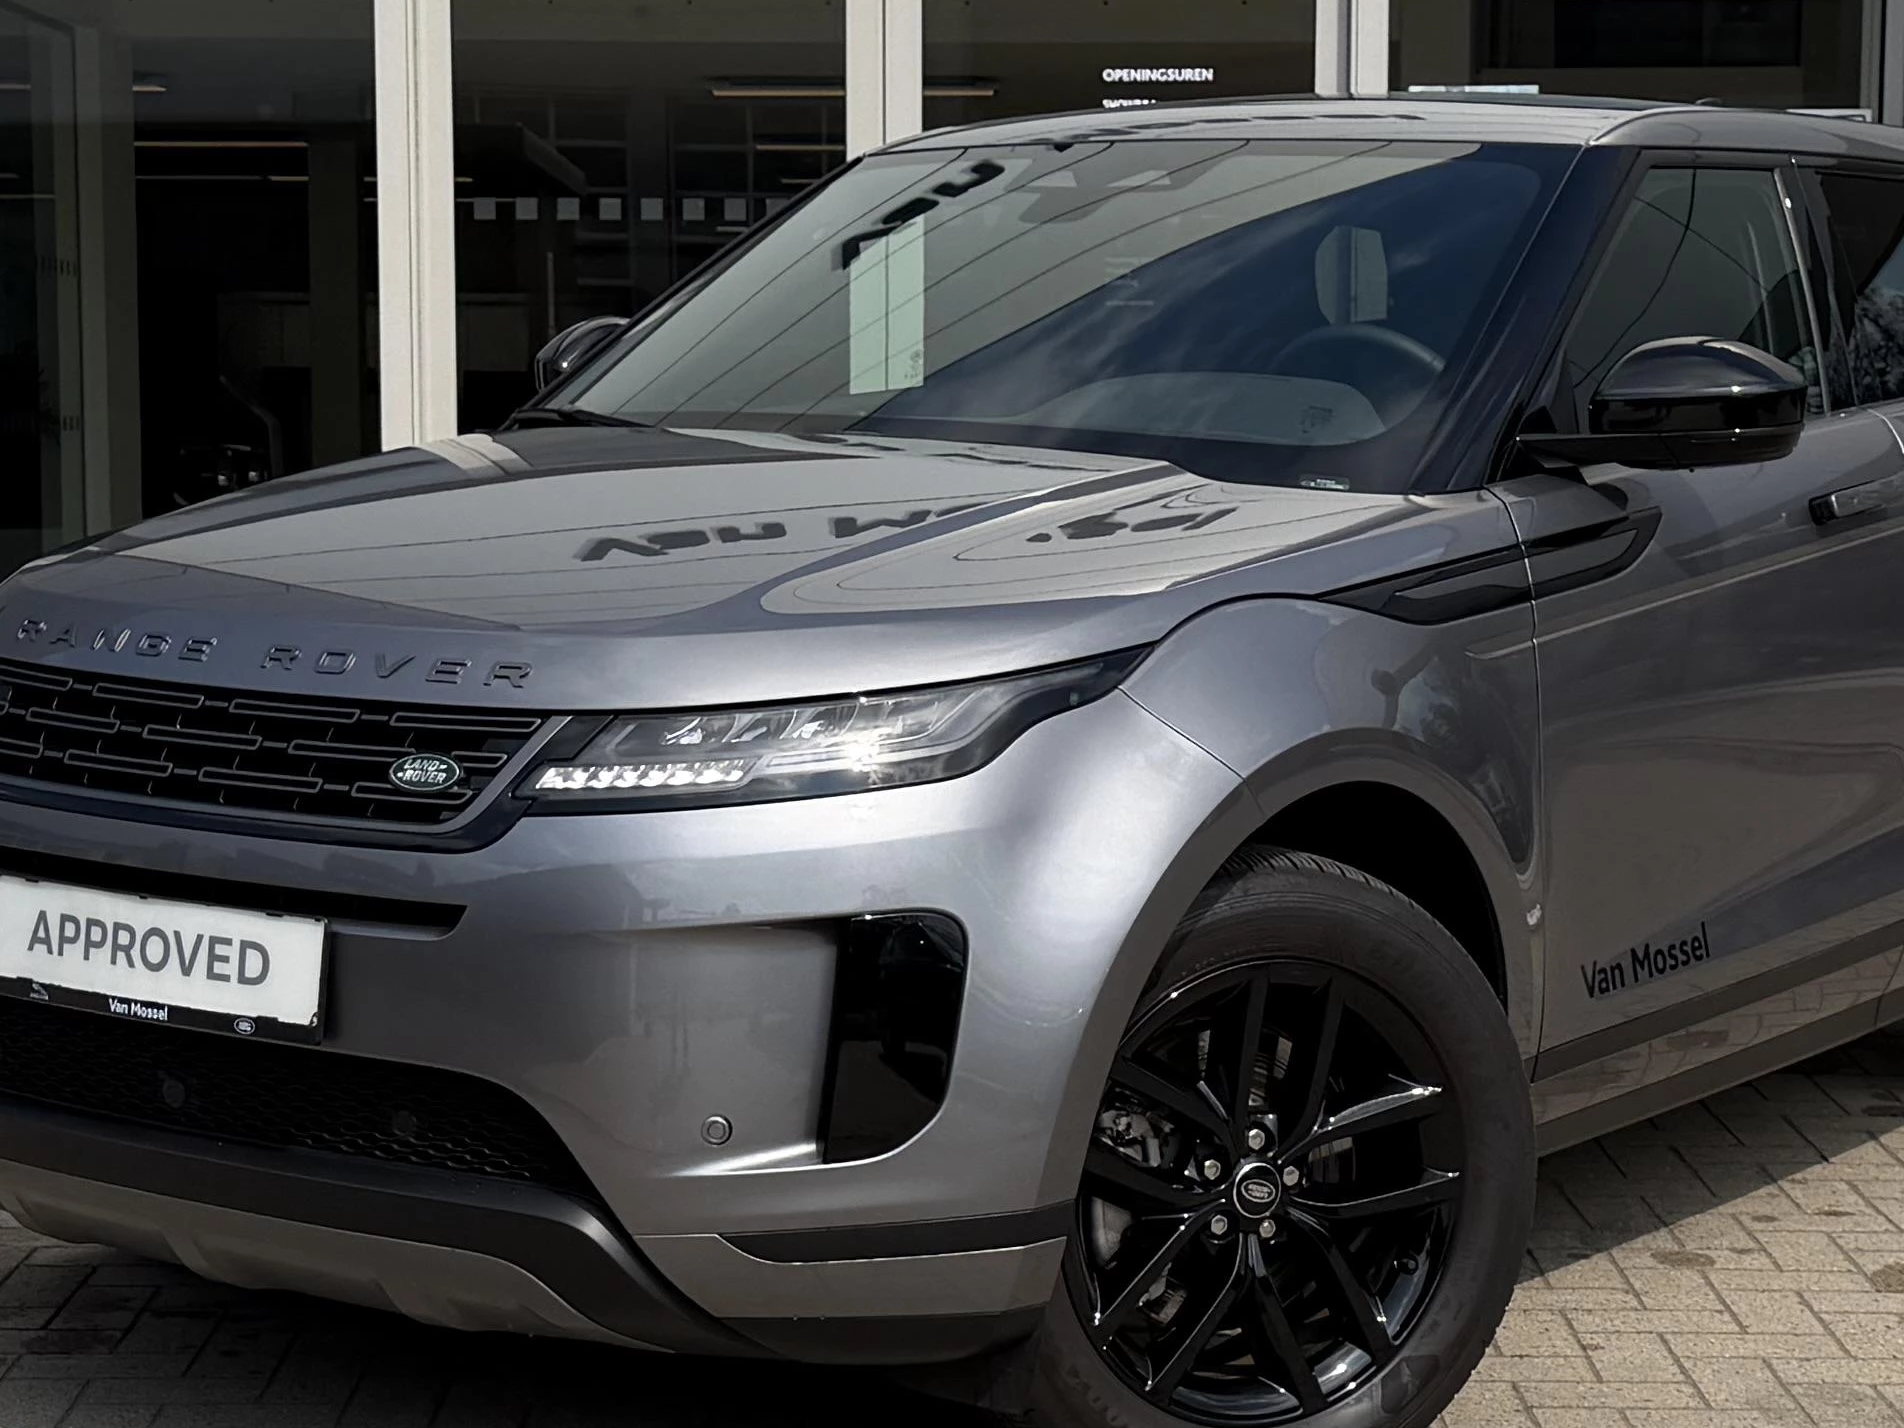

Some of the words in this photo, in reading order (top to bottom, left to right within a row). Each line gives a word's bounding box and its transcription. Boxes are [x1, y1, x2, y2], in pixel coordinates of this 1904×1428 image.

[1102, 67, 1214, 82] OPENINGSUREN
[17, 618, 218, 663] RANGE
[260, 643, 533, 689] ROVER
[403, 758, 440, 771] LAND
[403, 769, 447, 784] ROVER
[26, 908, 271, 987] APPROVED
[1580, 959, 1626, 998] Van
[1630, 920, 1711, 984] Mossel
[108, 997, 128, 1015] Van
[130, 1001, 168, 1022] Mossel
